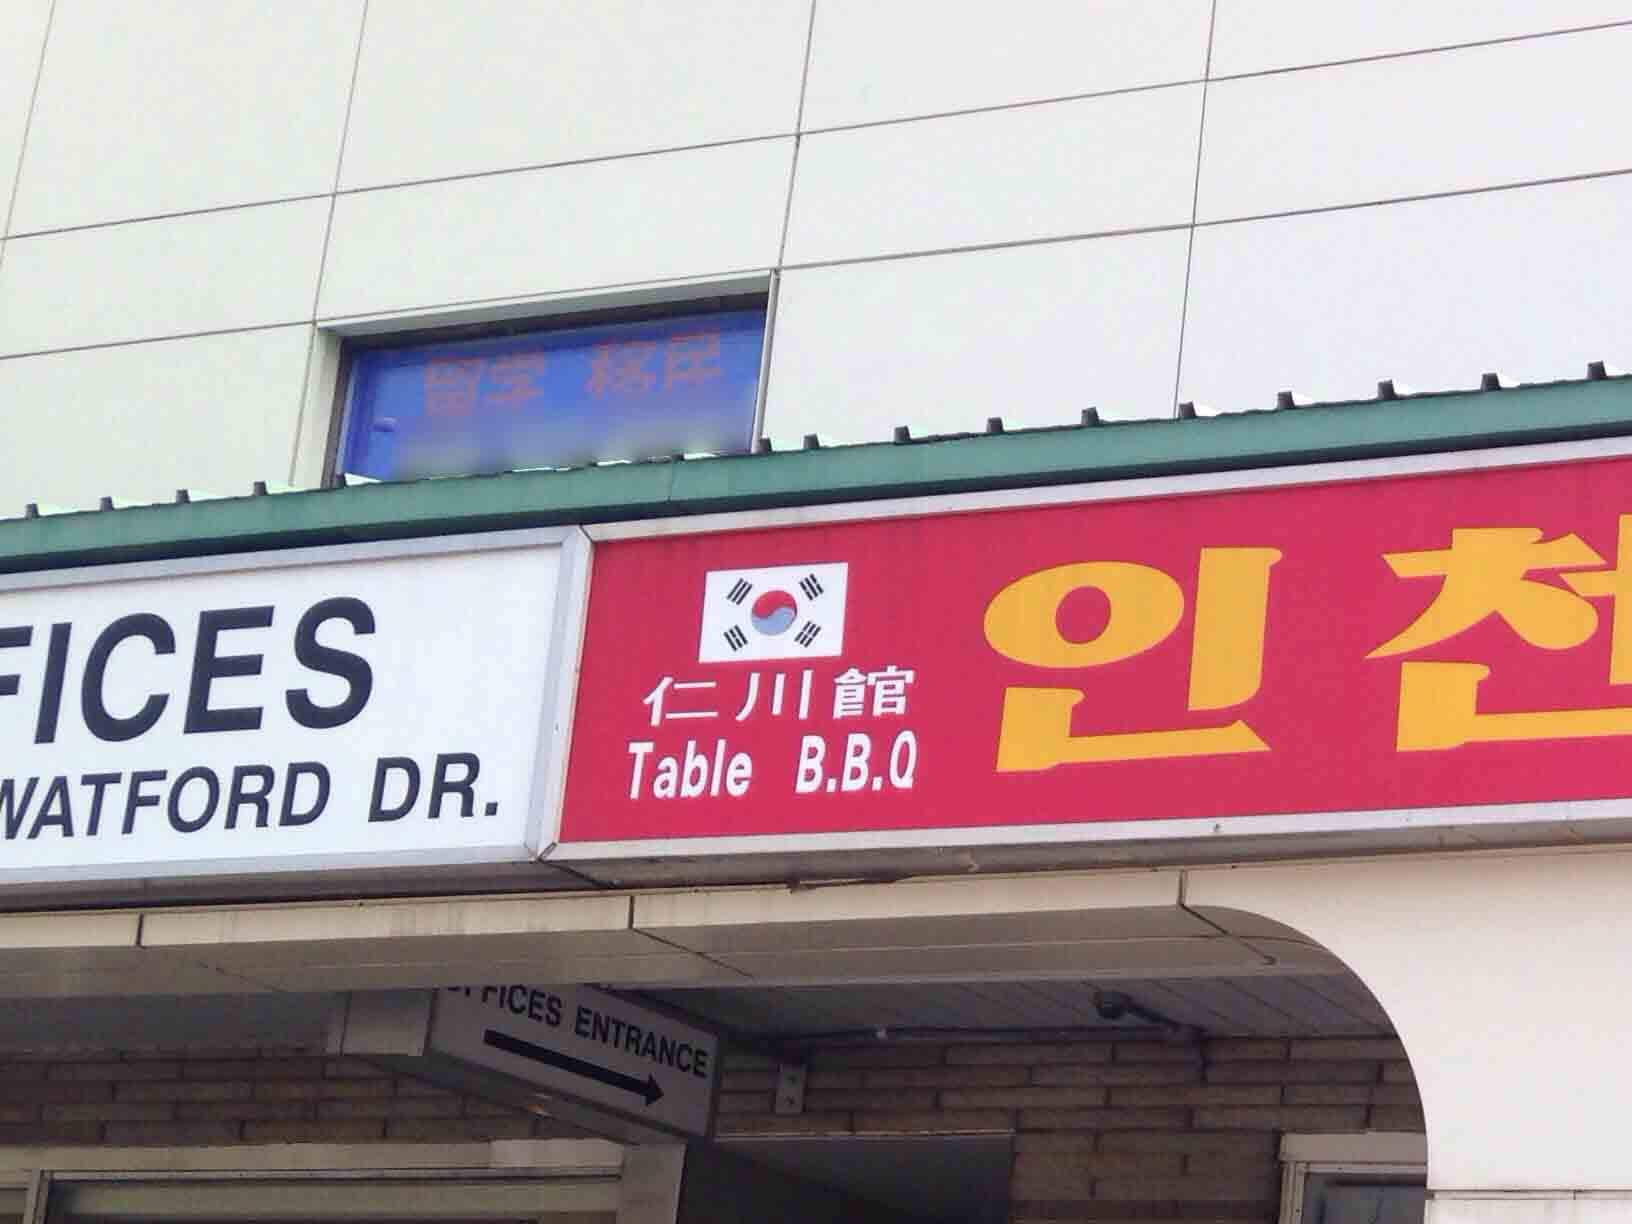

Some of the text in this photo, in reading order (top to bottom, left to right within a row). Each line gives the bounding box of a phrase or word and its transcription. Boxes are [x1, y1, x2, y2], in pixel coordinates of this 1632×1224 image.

[643, 665, 916, 727] 仁川館
[368, 752, 499, 823] DR.
[628, 730, 918, 800] Table B.B.Q
[447, 985, 708, 1078] ICES ENTRANCE
